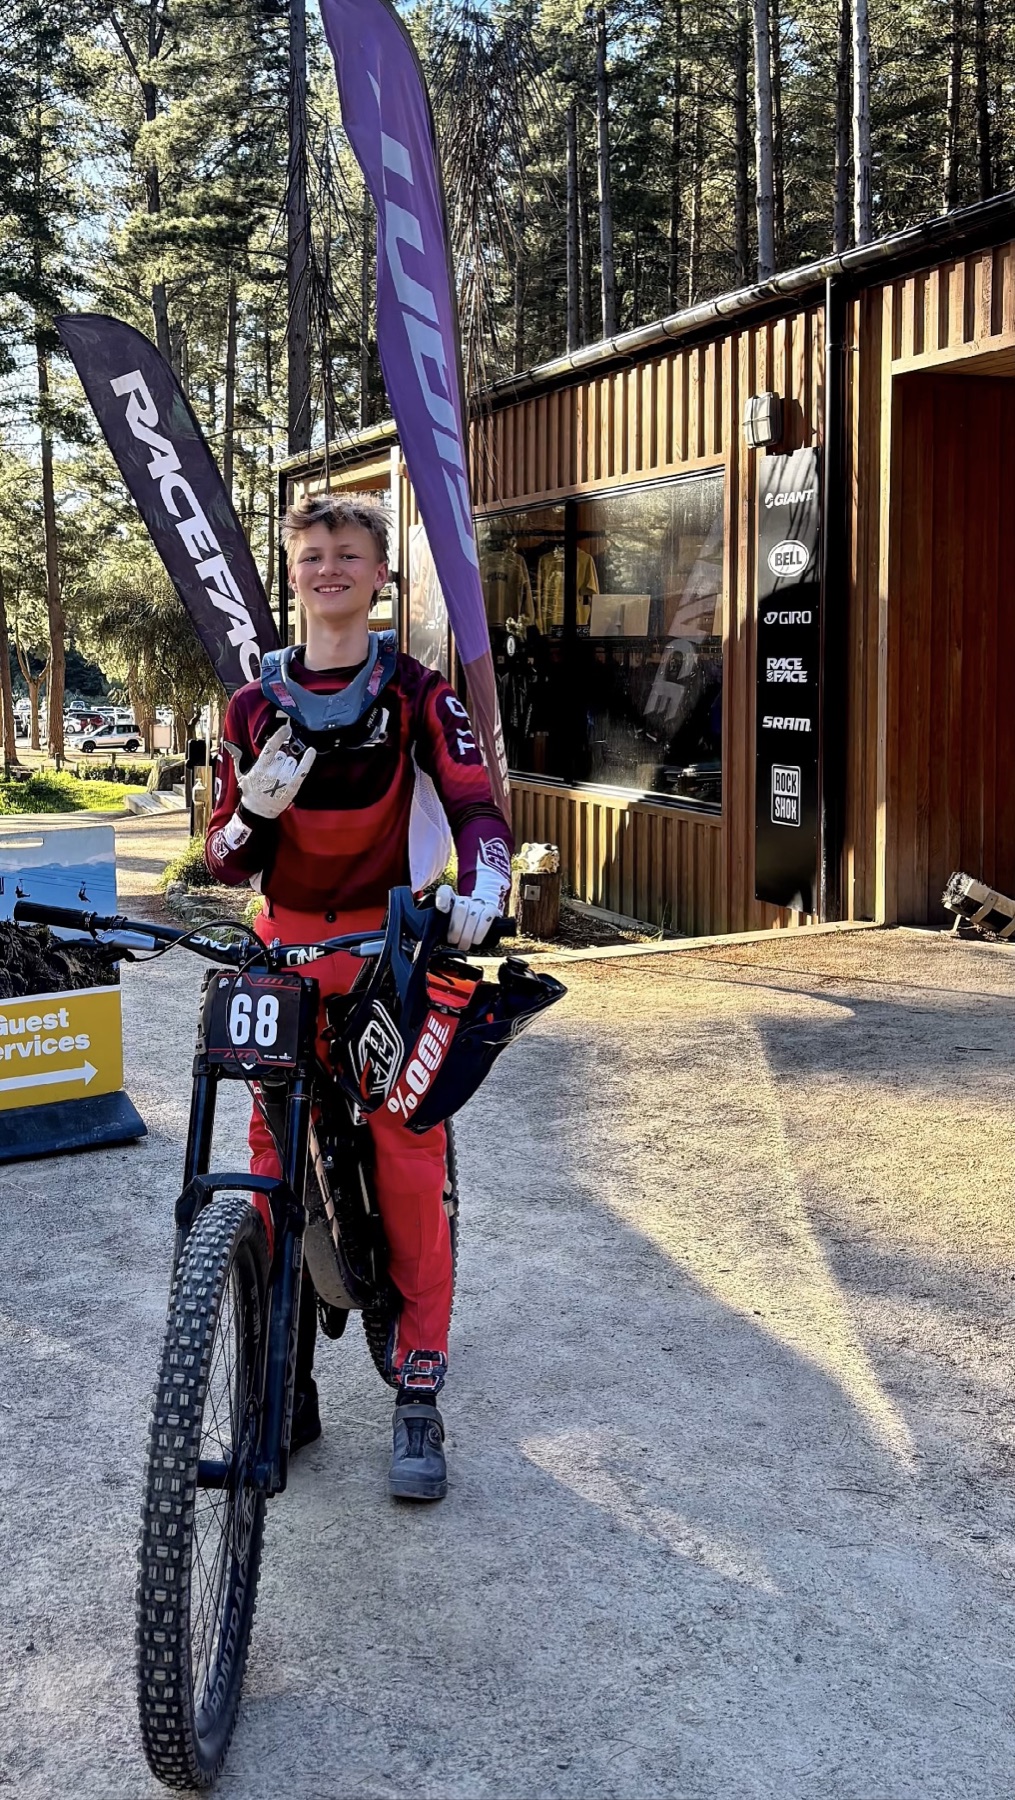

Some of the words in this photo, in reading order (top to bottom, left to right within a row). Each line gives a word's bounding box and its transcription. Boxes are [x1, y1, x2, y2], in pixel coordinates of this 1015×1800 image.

[774, 488, 814, 506] GIANT
[109, 369, 260, 683] RACEFAC
[774, 550, 803, 567] BELL
[778, 610, 812, 625] GIRO
[766, 657, 803, 670] RACE
[773, 670, 808, 683] FACE
[762, 715, 811, 732] SRAM
[775, 771, 797, 794] ROCK
[774, 796, 797, 820] SHOX
[229, 993, 279, 1047] 68
[387, 1015, 450, 1119] 100%
